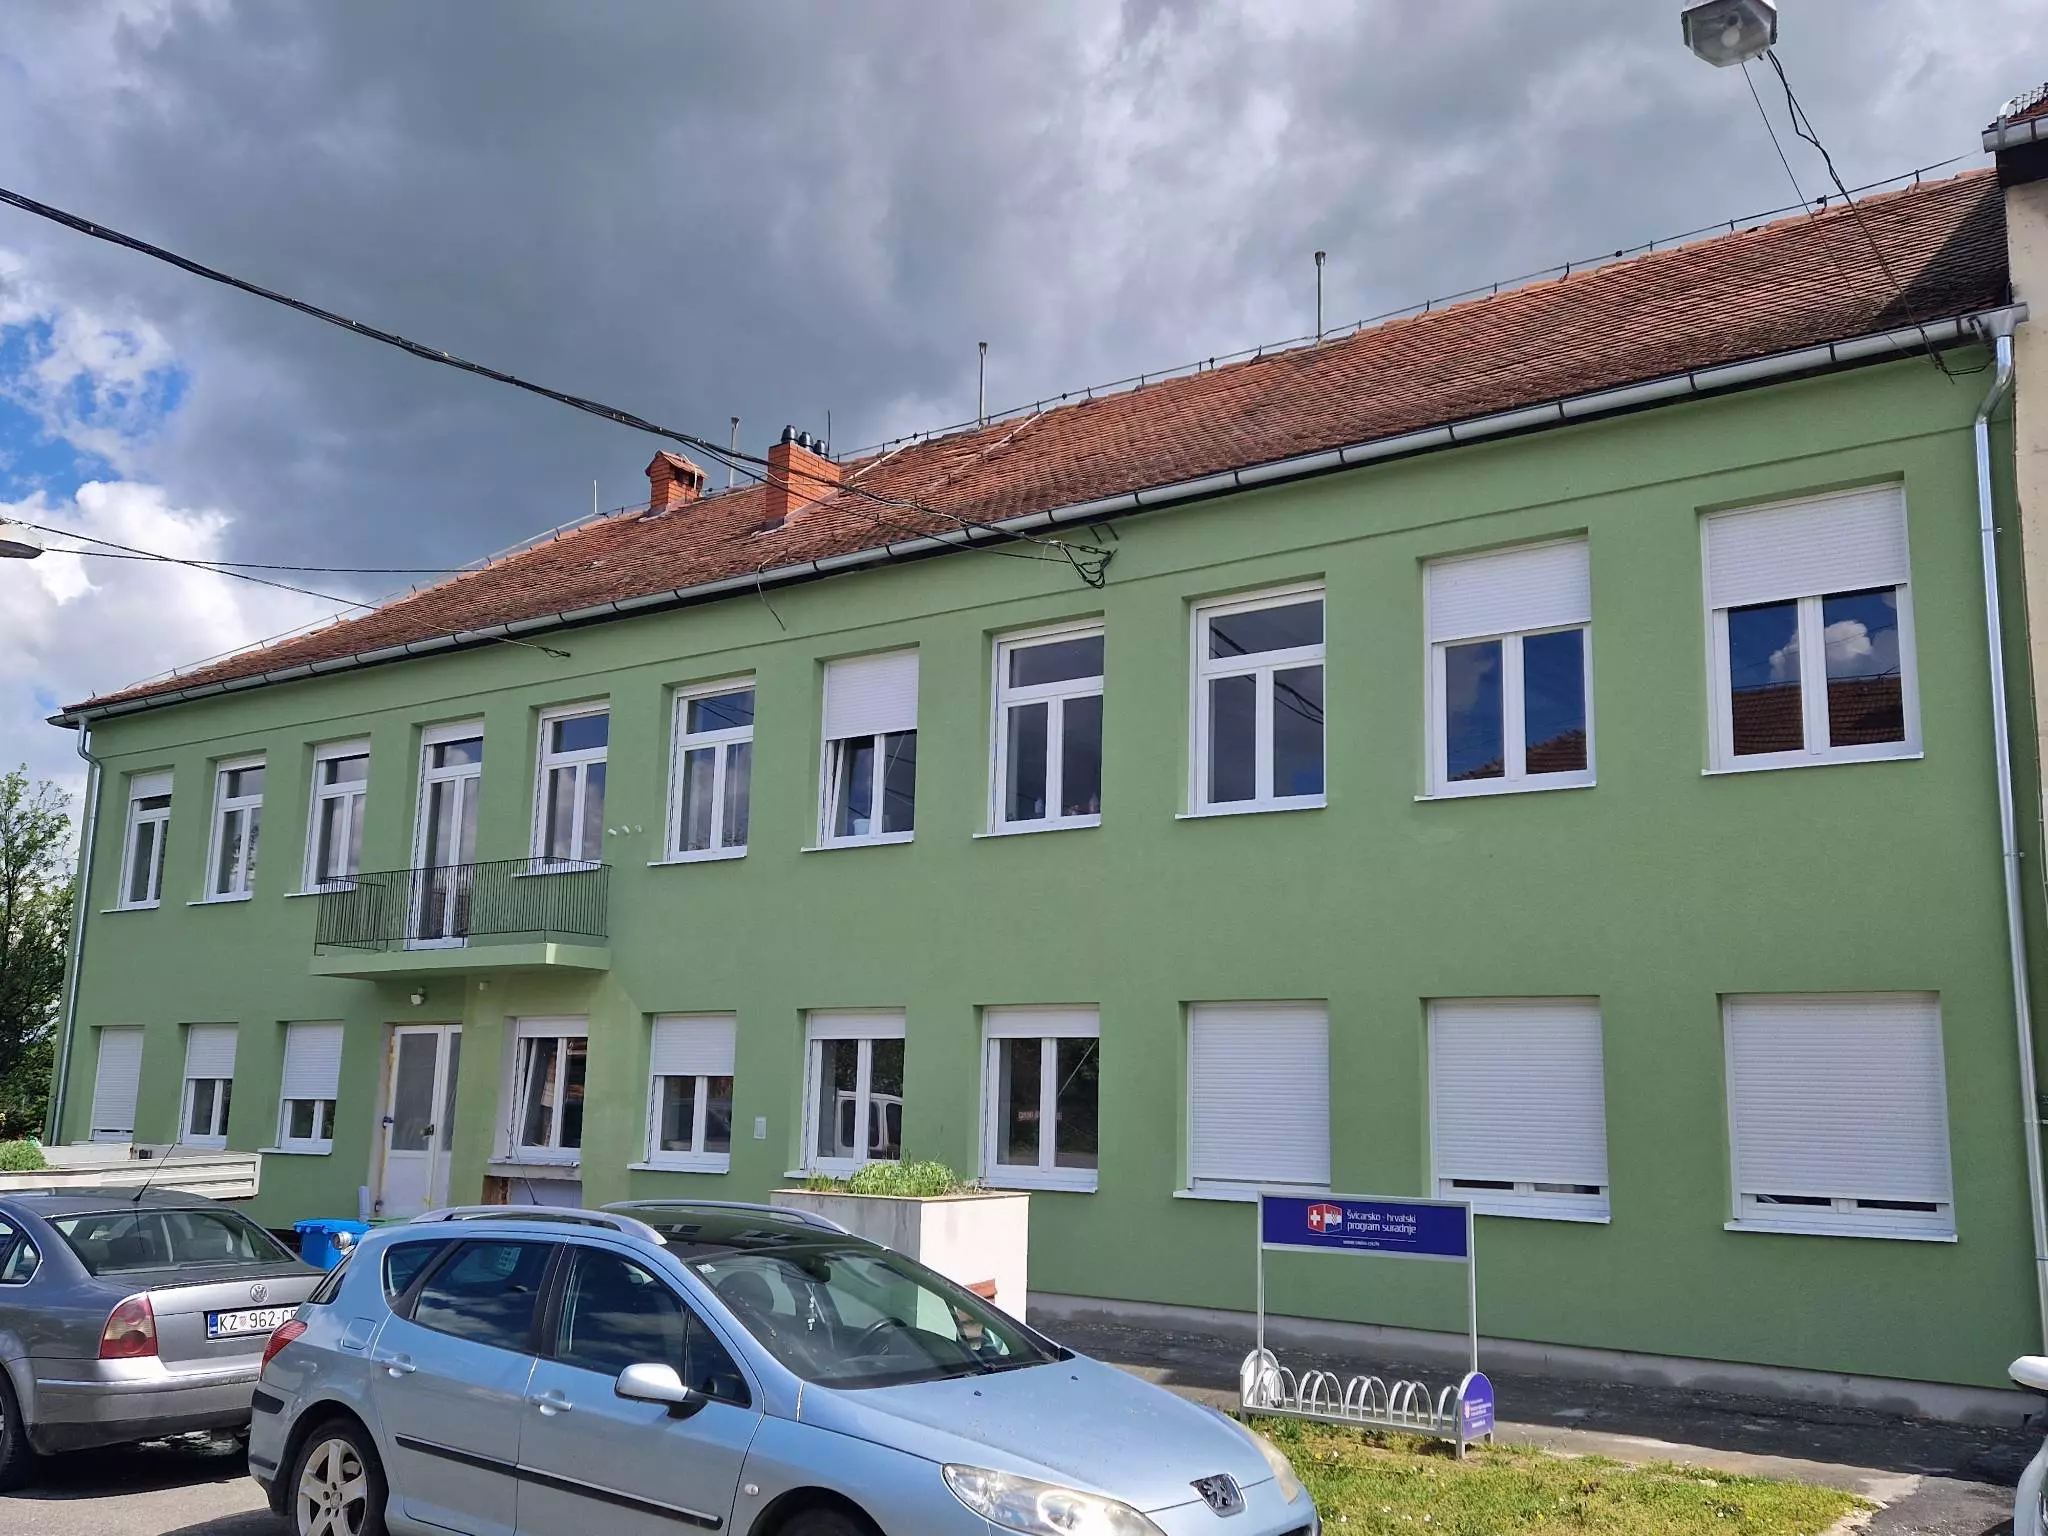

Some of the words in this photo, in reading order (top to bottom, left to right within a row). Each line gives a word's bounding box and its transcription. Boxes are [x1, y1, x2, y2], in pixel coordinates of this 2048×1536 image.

[1386, 1213, 1416, 1223] hrvatski
[1347, 1221, 1381, 1232] program
[1381, 1223, 1417, 1236] suradnje
[219, 1314, 238, 1332] KZ
